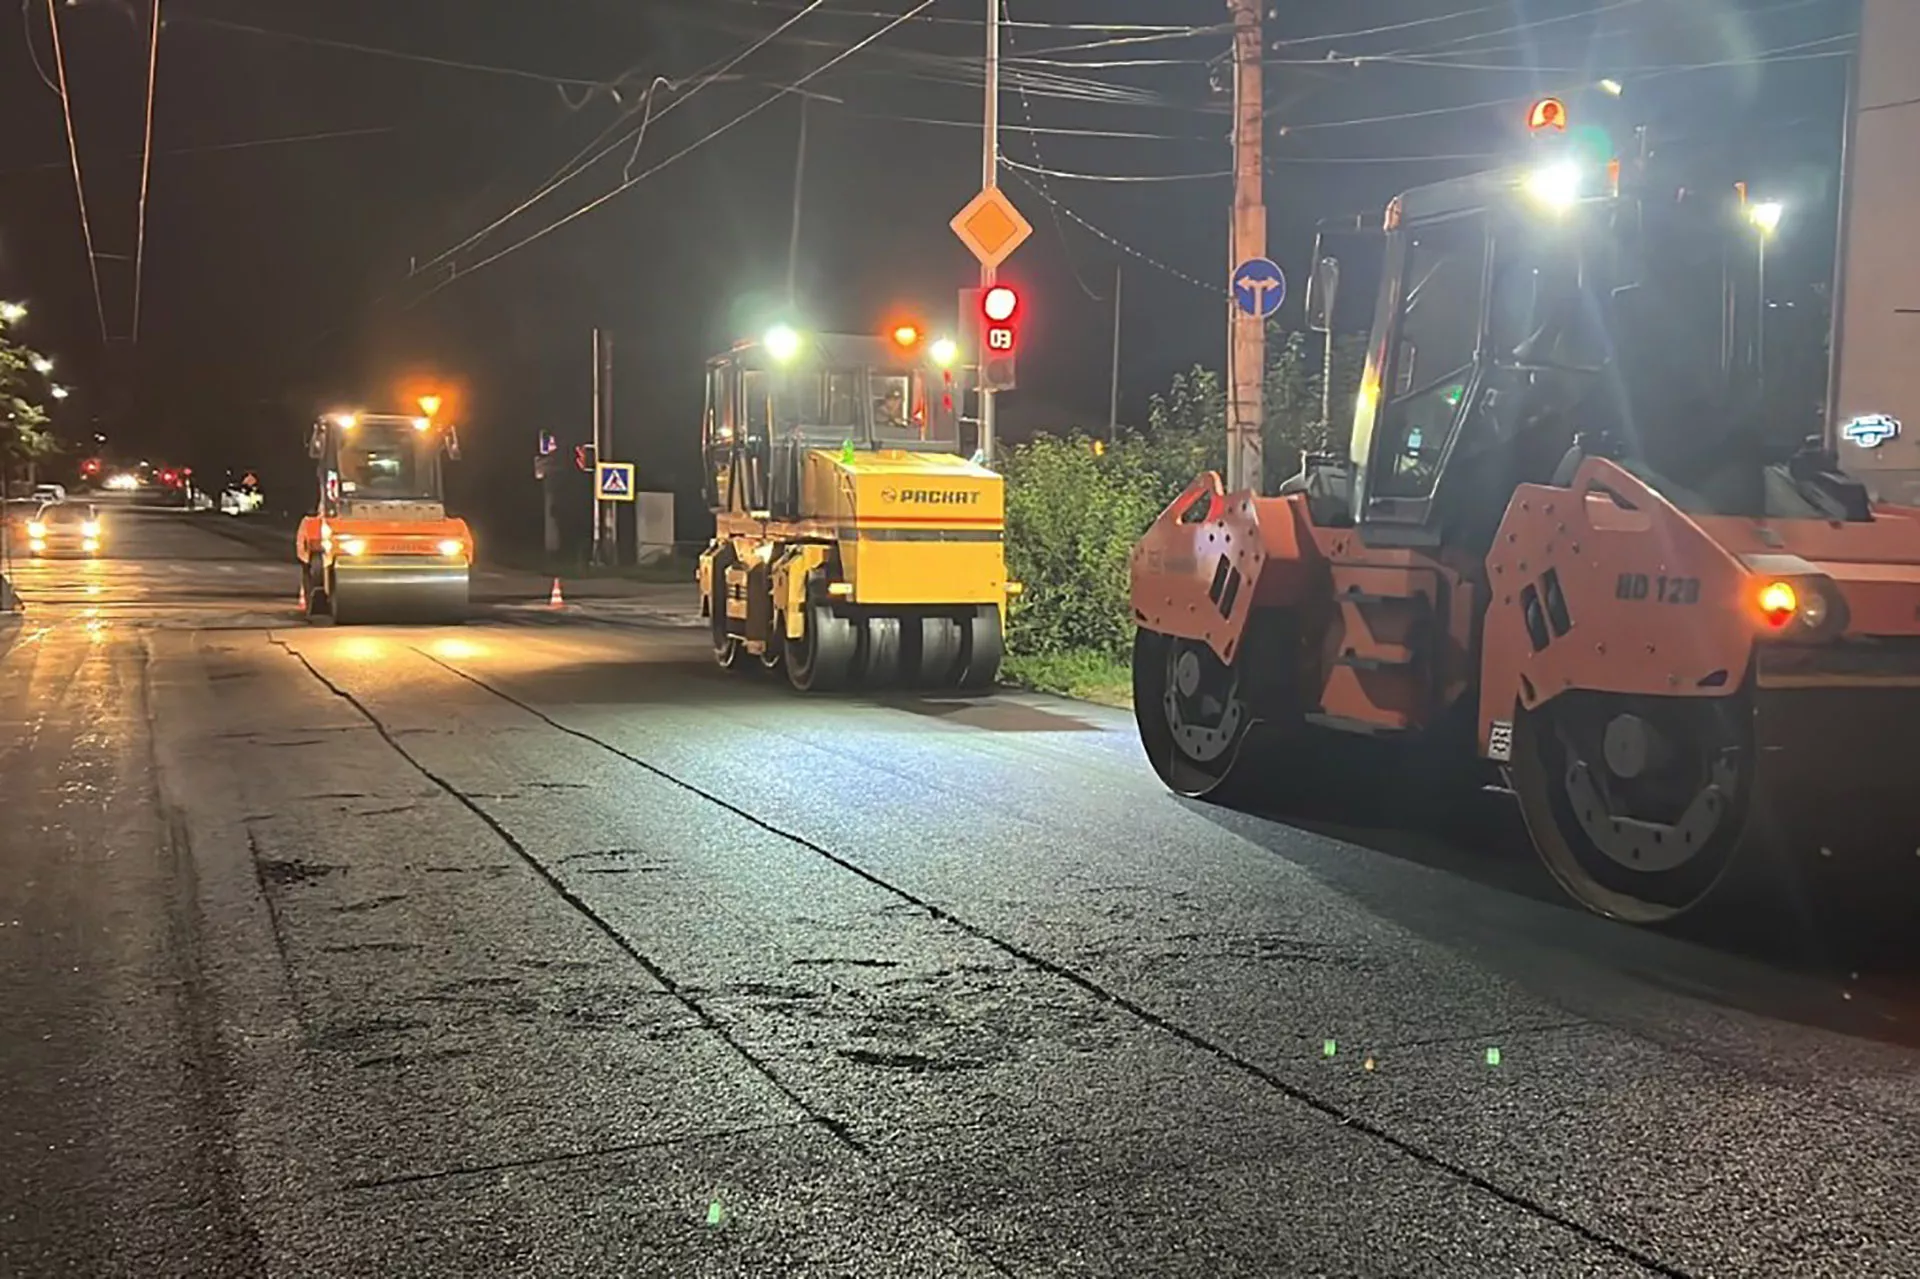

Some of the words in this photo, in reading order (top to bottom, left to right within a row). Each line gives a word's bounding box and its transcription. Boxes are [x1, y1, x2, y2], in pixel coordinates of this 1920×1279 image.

[990, 328, 1012, 349] 03
[900, 489, 980, 504] РАСКАТ
[1615, 573, 1650, 599] HD
